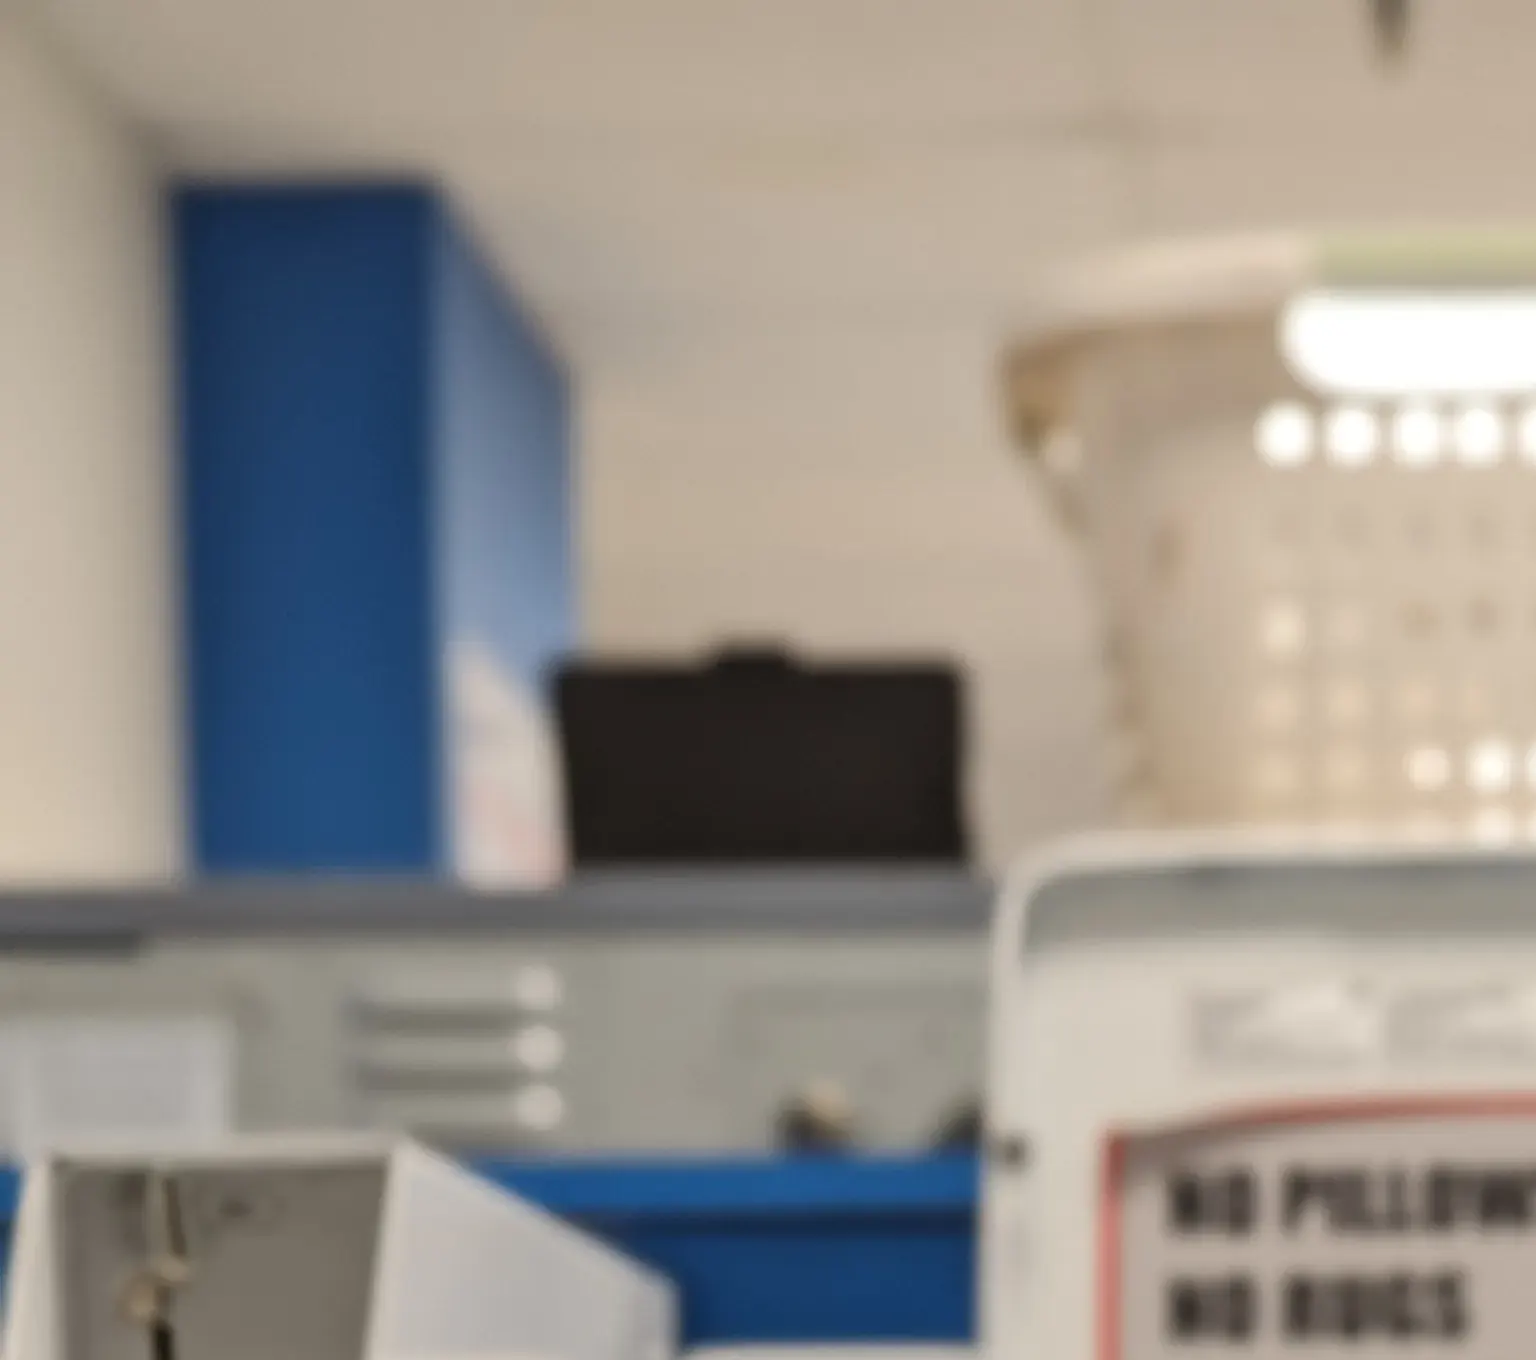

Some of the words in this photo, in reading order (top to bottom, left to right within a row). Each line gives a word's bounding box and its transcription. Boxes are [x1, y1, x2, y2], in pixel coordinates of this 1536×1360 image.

[1167, 1169, 1258, 1236] NO
[1166, 1274, 1259, 1344] NO
[1281, 1271, 1468, 1343] RUGS
